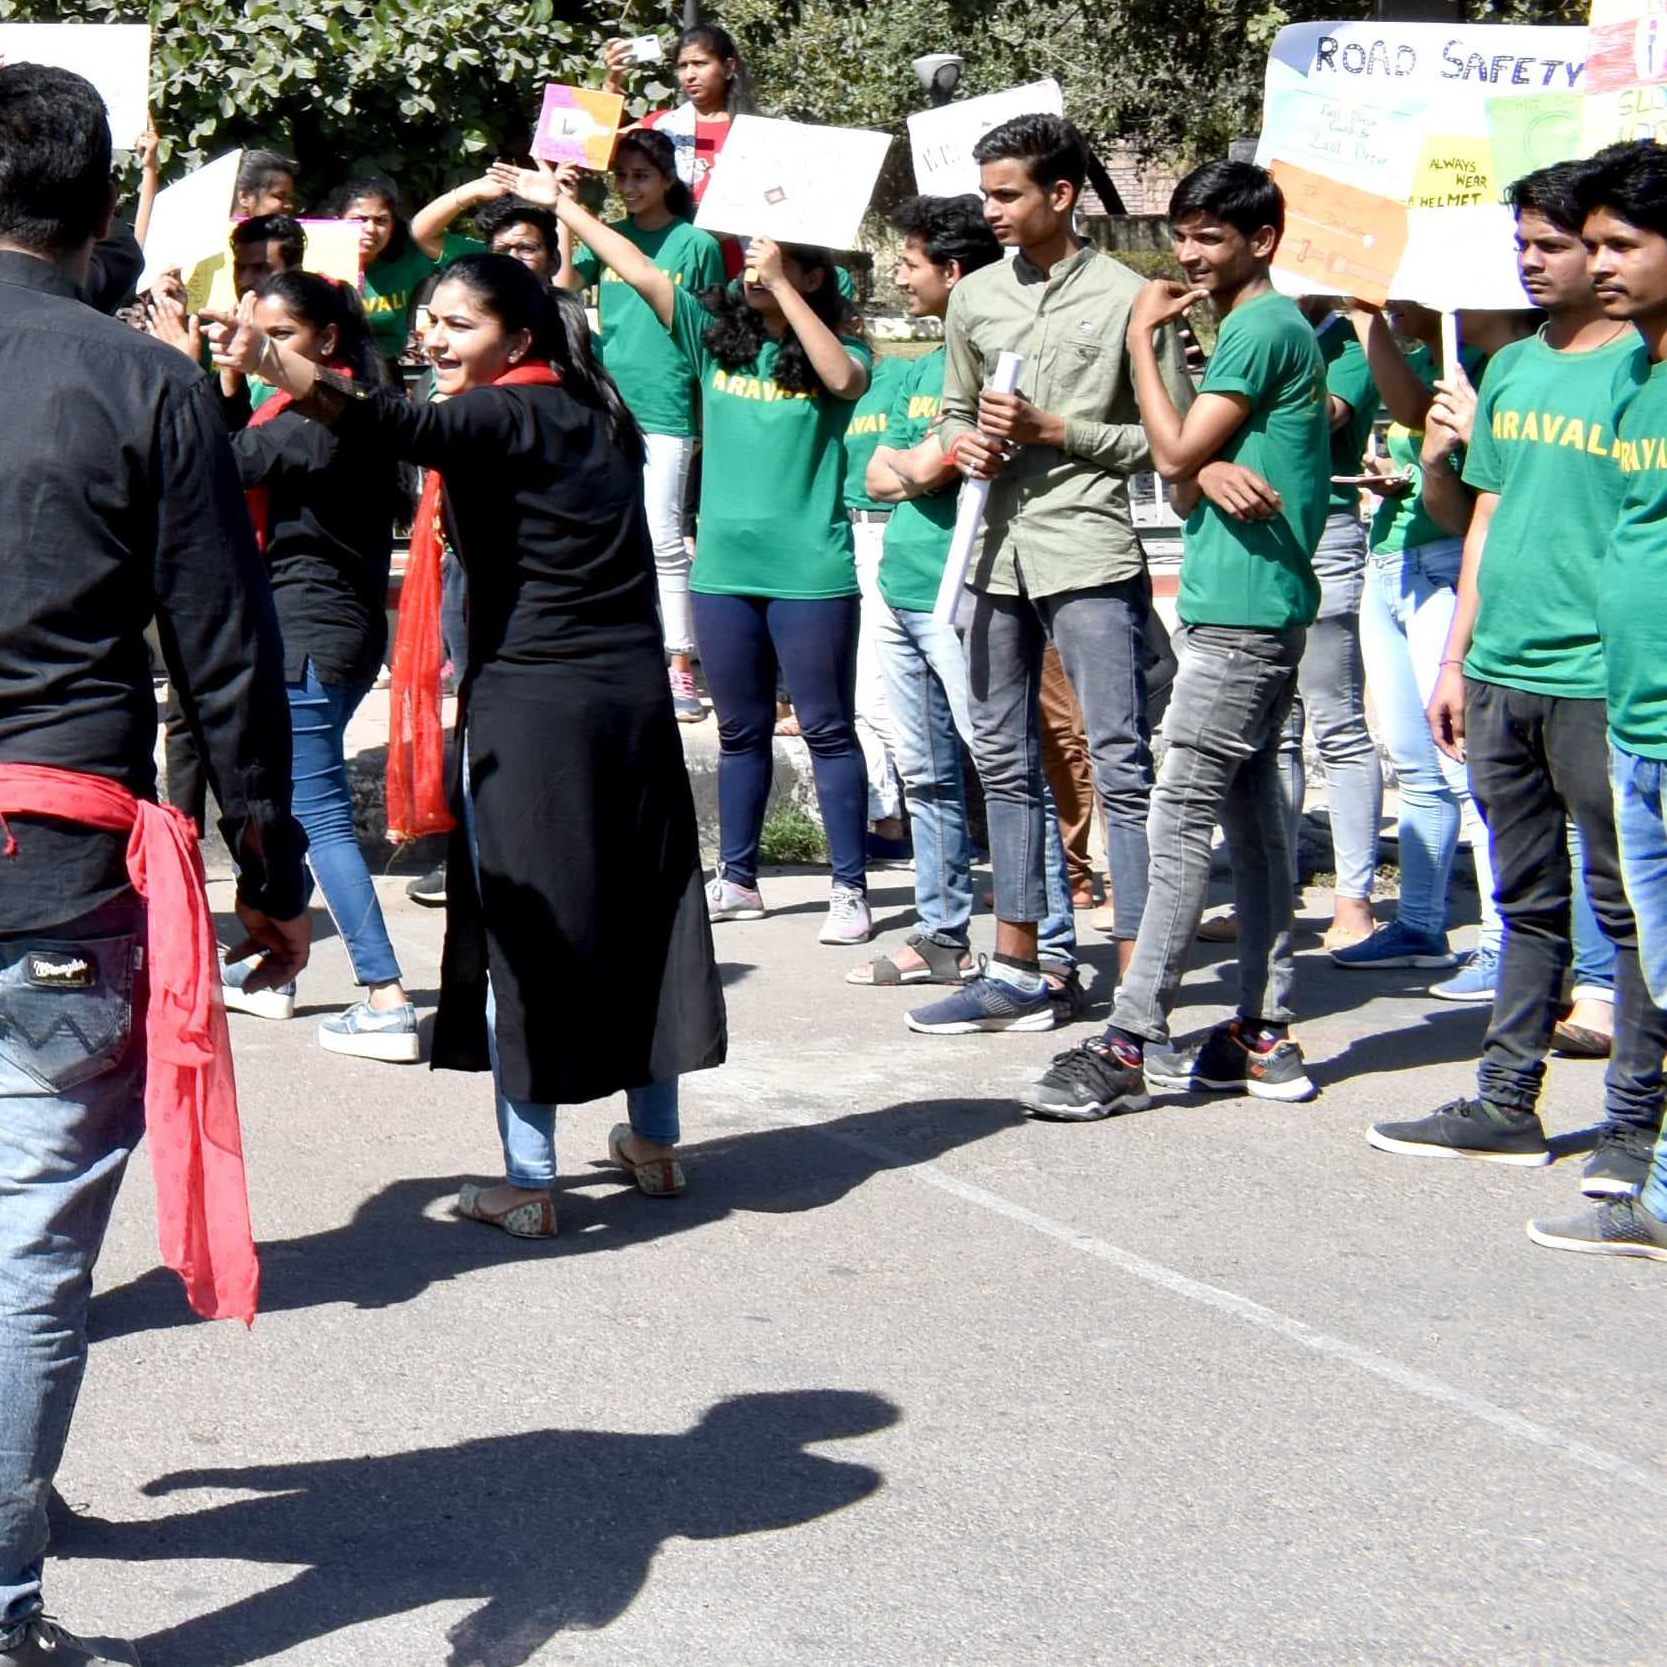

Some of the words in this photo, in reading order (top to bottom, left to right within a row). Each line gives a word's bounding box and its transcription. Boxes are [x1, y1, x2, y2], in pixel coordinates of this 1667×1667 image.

[1316, 36, 1417, 77] ROAD
[1440, 38, 1585, 87] SAFETY
[1430, 157, 1476, 172] ALWAYS
[1456, 175, 1487, 189] WEAR
[1420, 193, 1482, 208] HELMET
